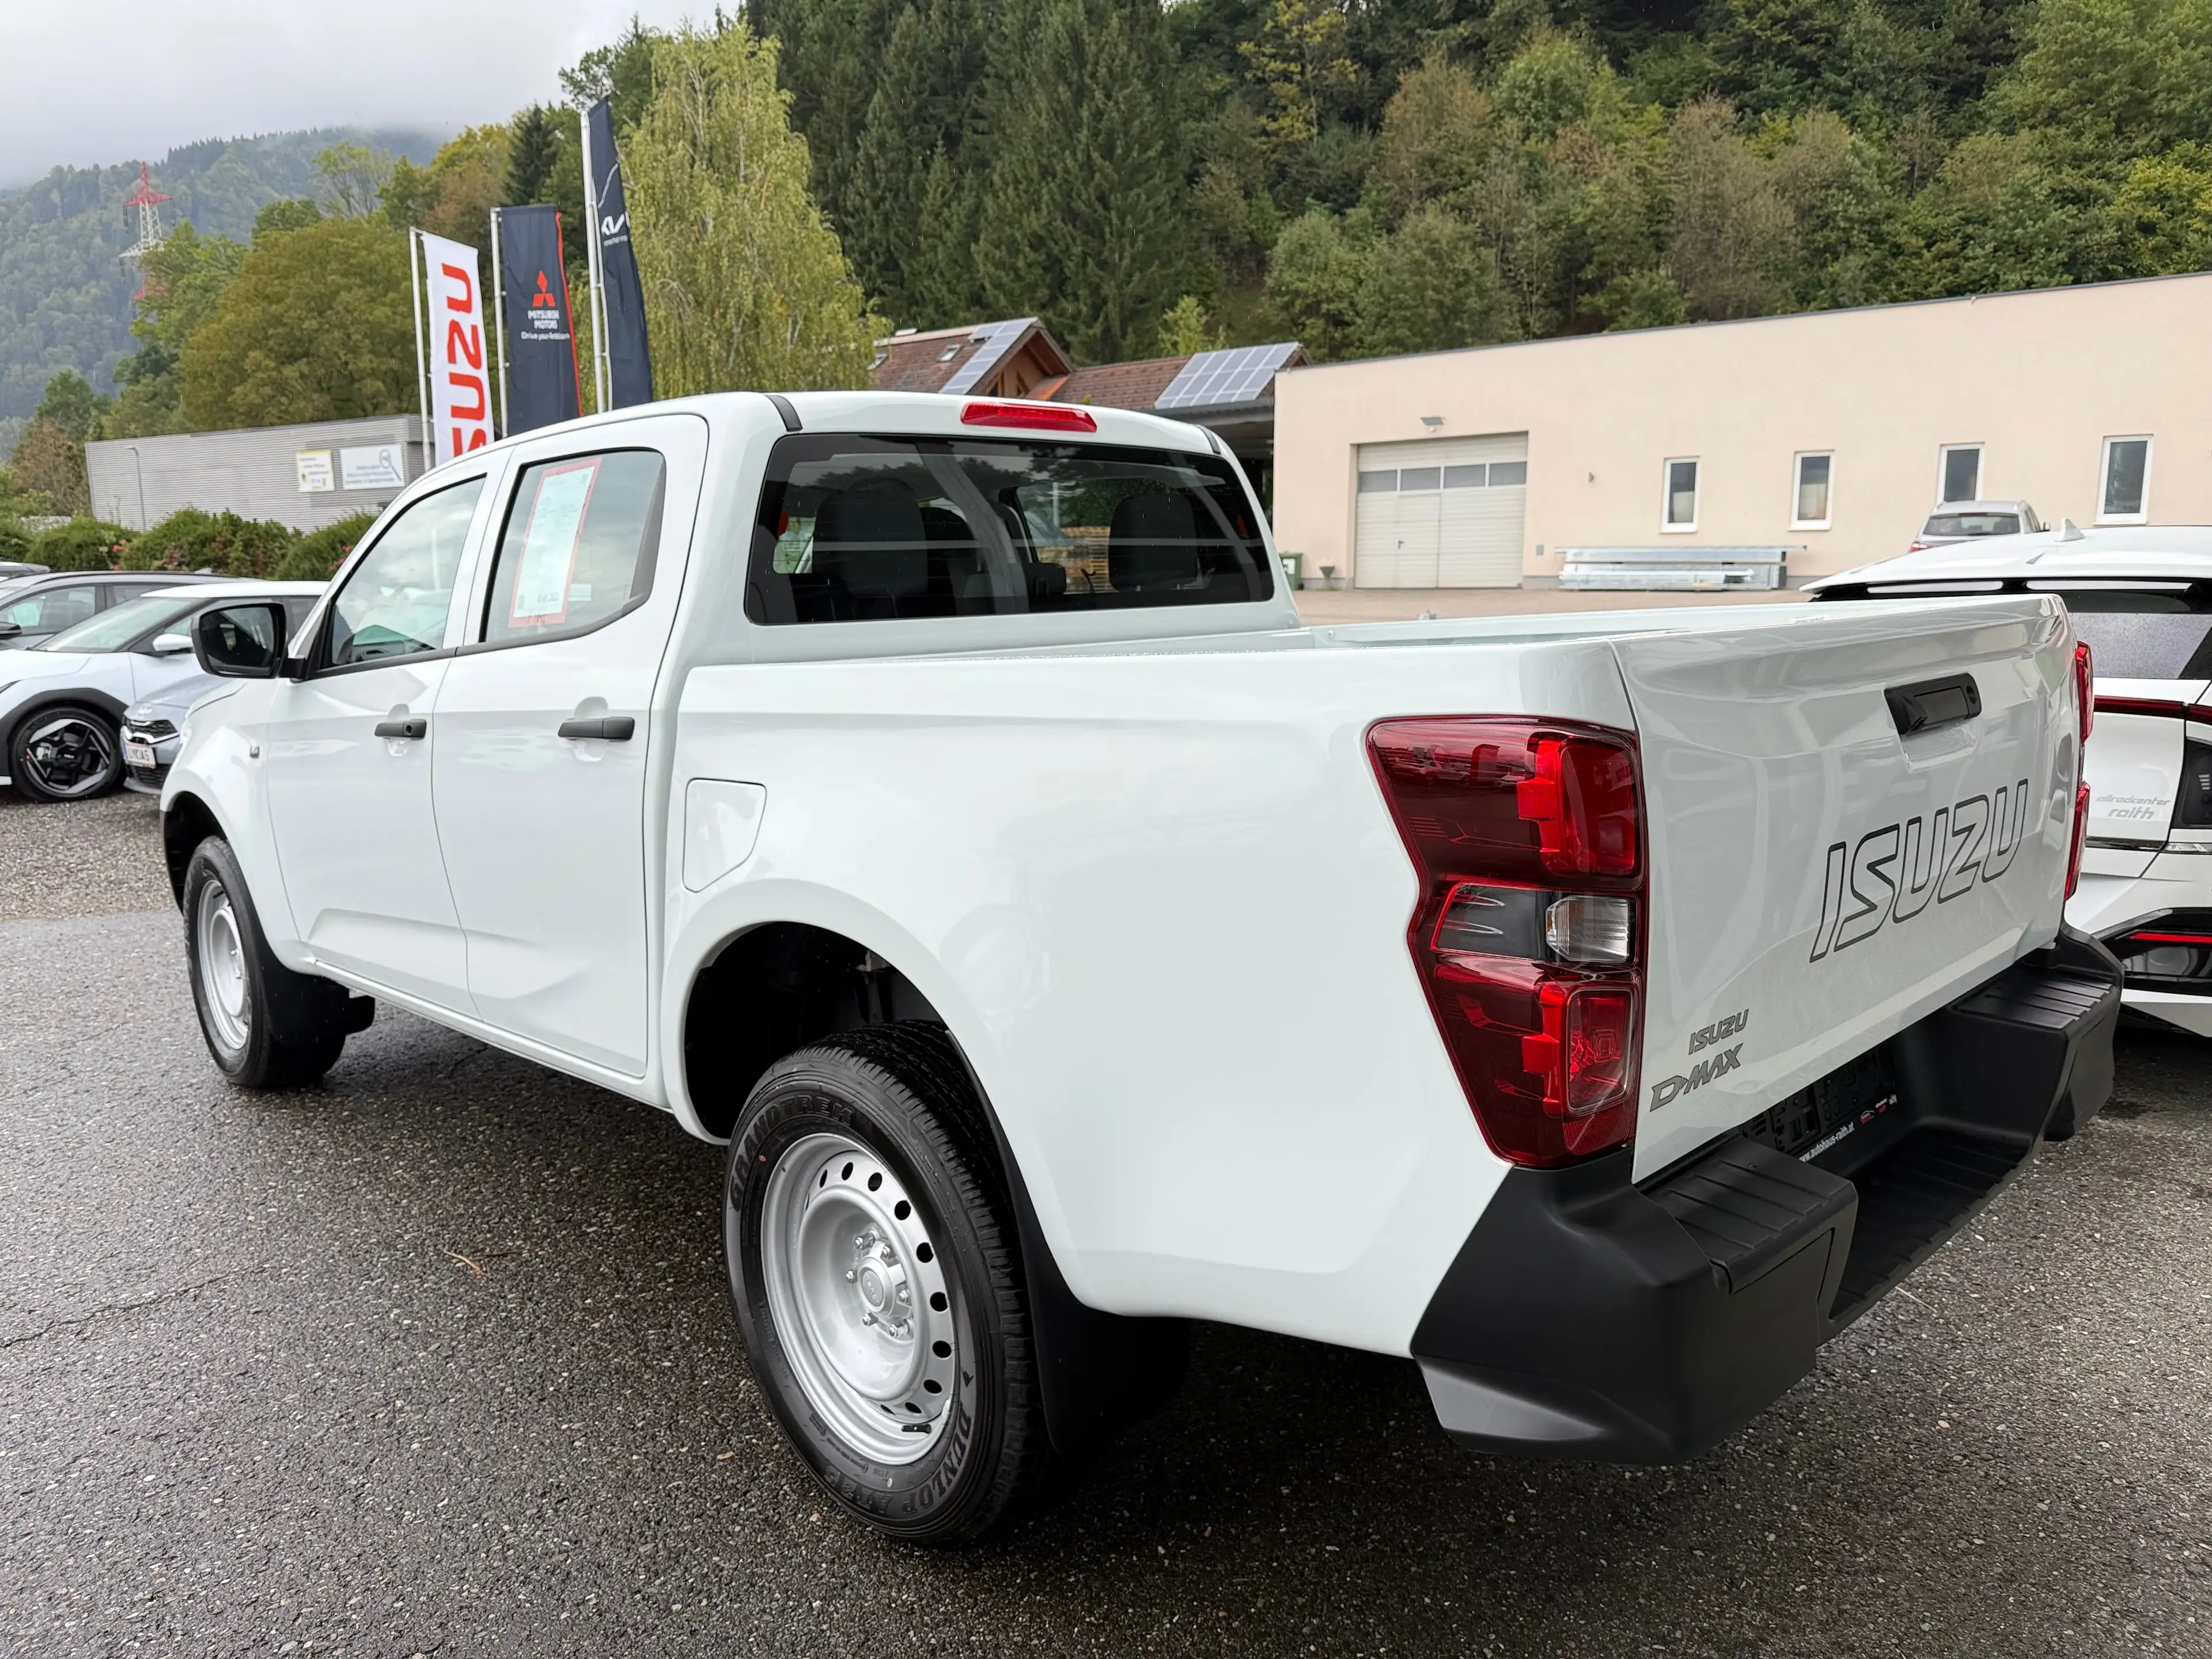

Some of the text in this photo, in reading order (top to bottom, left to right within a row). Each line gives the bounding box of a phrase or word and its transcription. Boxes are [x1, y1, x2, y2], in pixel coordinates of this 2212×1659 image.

[441, 263, 487, 458] SUZU
[2096, 794, 2171, 805] allradcenter
[2107, 806, 2154, 819] raith
[1809, 778, 2028, 963] ISUZU
[1688, 1008, 1749, 1055] ISUZU
[1798, 1121, 1855, 1162] ww.autohaus-raith.at
[902, 1400, 971, 1514] DUNLOP
